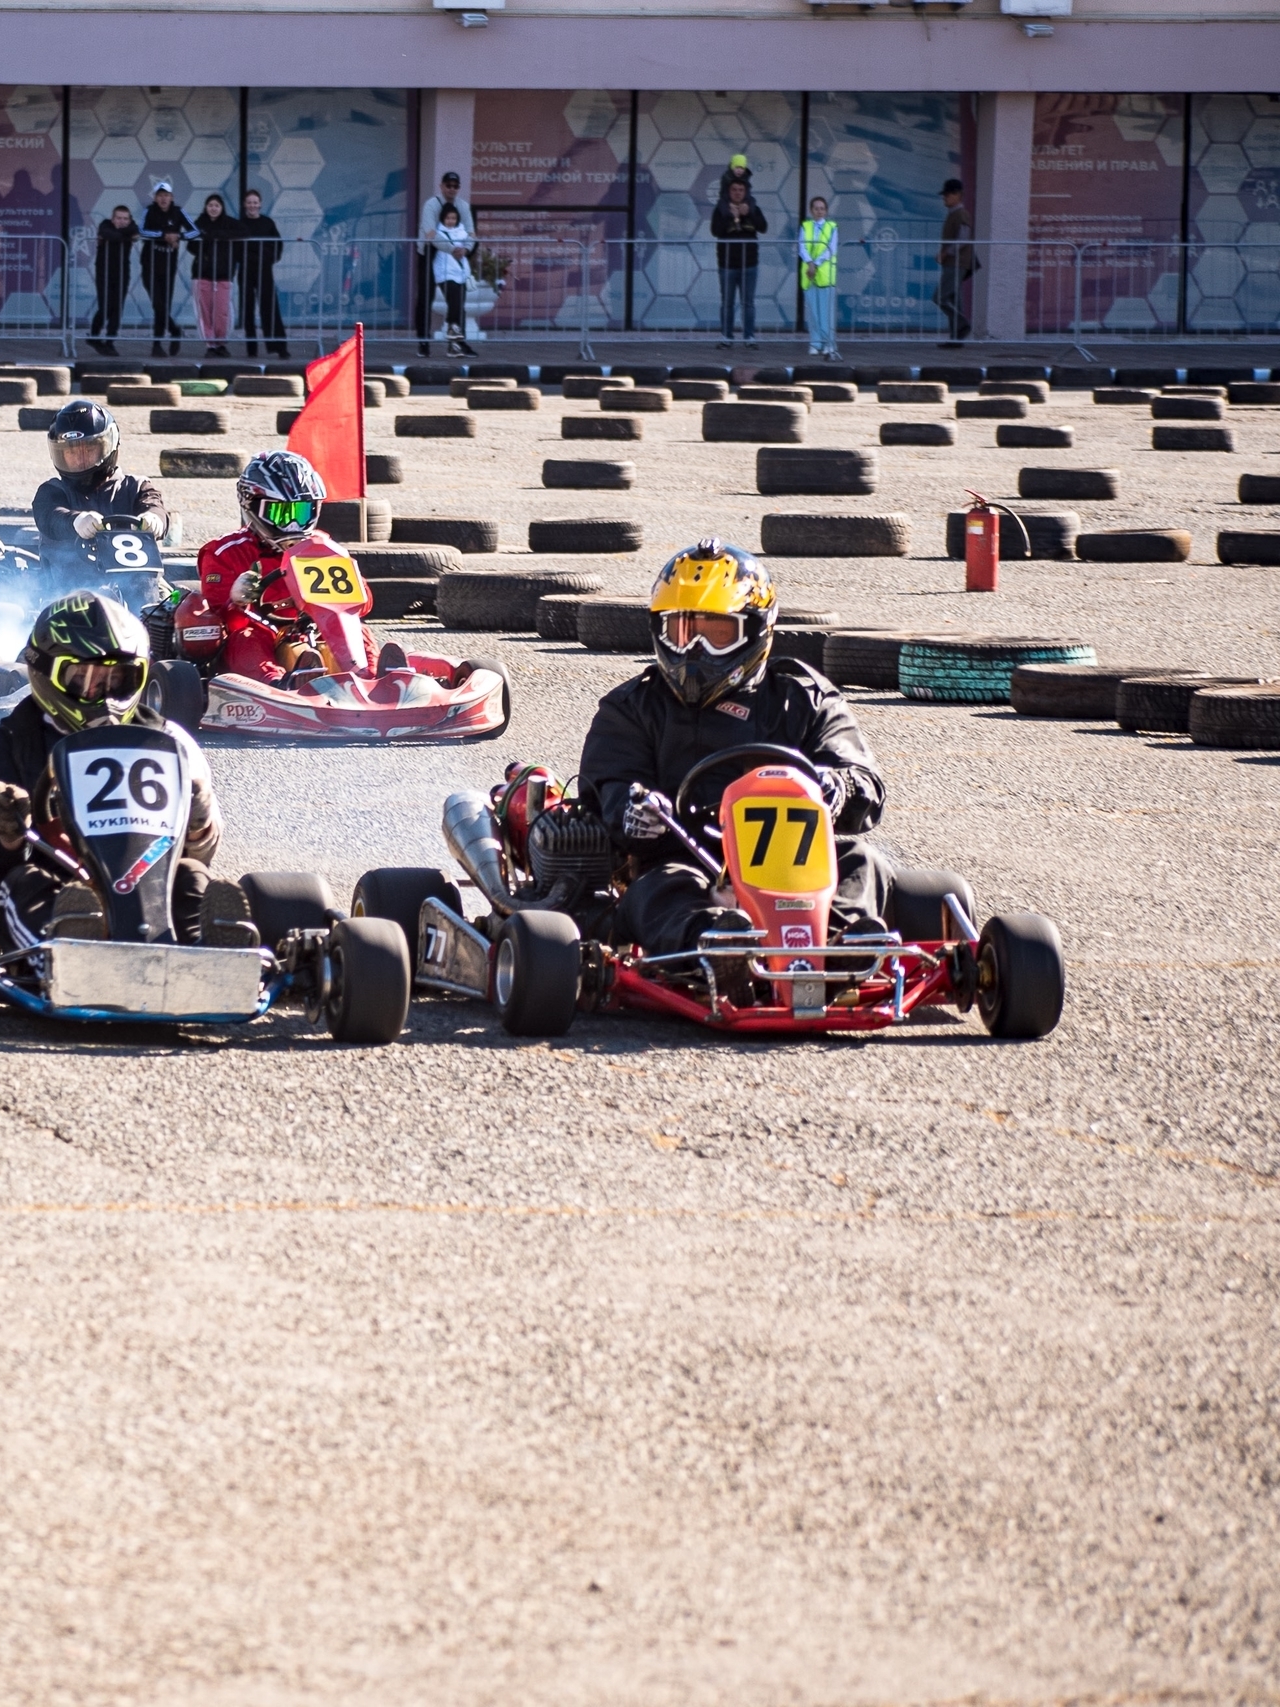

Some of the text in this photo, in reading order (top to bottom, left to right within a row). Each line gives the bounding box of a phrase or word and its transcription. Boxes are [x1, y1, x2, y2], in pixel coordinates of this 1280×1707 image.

[472, 141, 533, 153] КУЛЬТЕТ
[471, 170, 582, 183] ЧИСЛИТЕЛЬНОЙ
[561, 157, 571, 169] И
[1031, 160, 1159, 171] АВЛЕНИЯ И ПРАВА
[111, 533, 149, 568] 8
[303, 566, 354, 594] 28
[84, 757, 169, 813] 26
[744, 807, 819, 867] 77
[426, 926, 447, 963] 77
